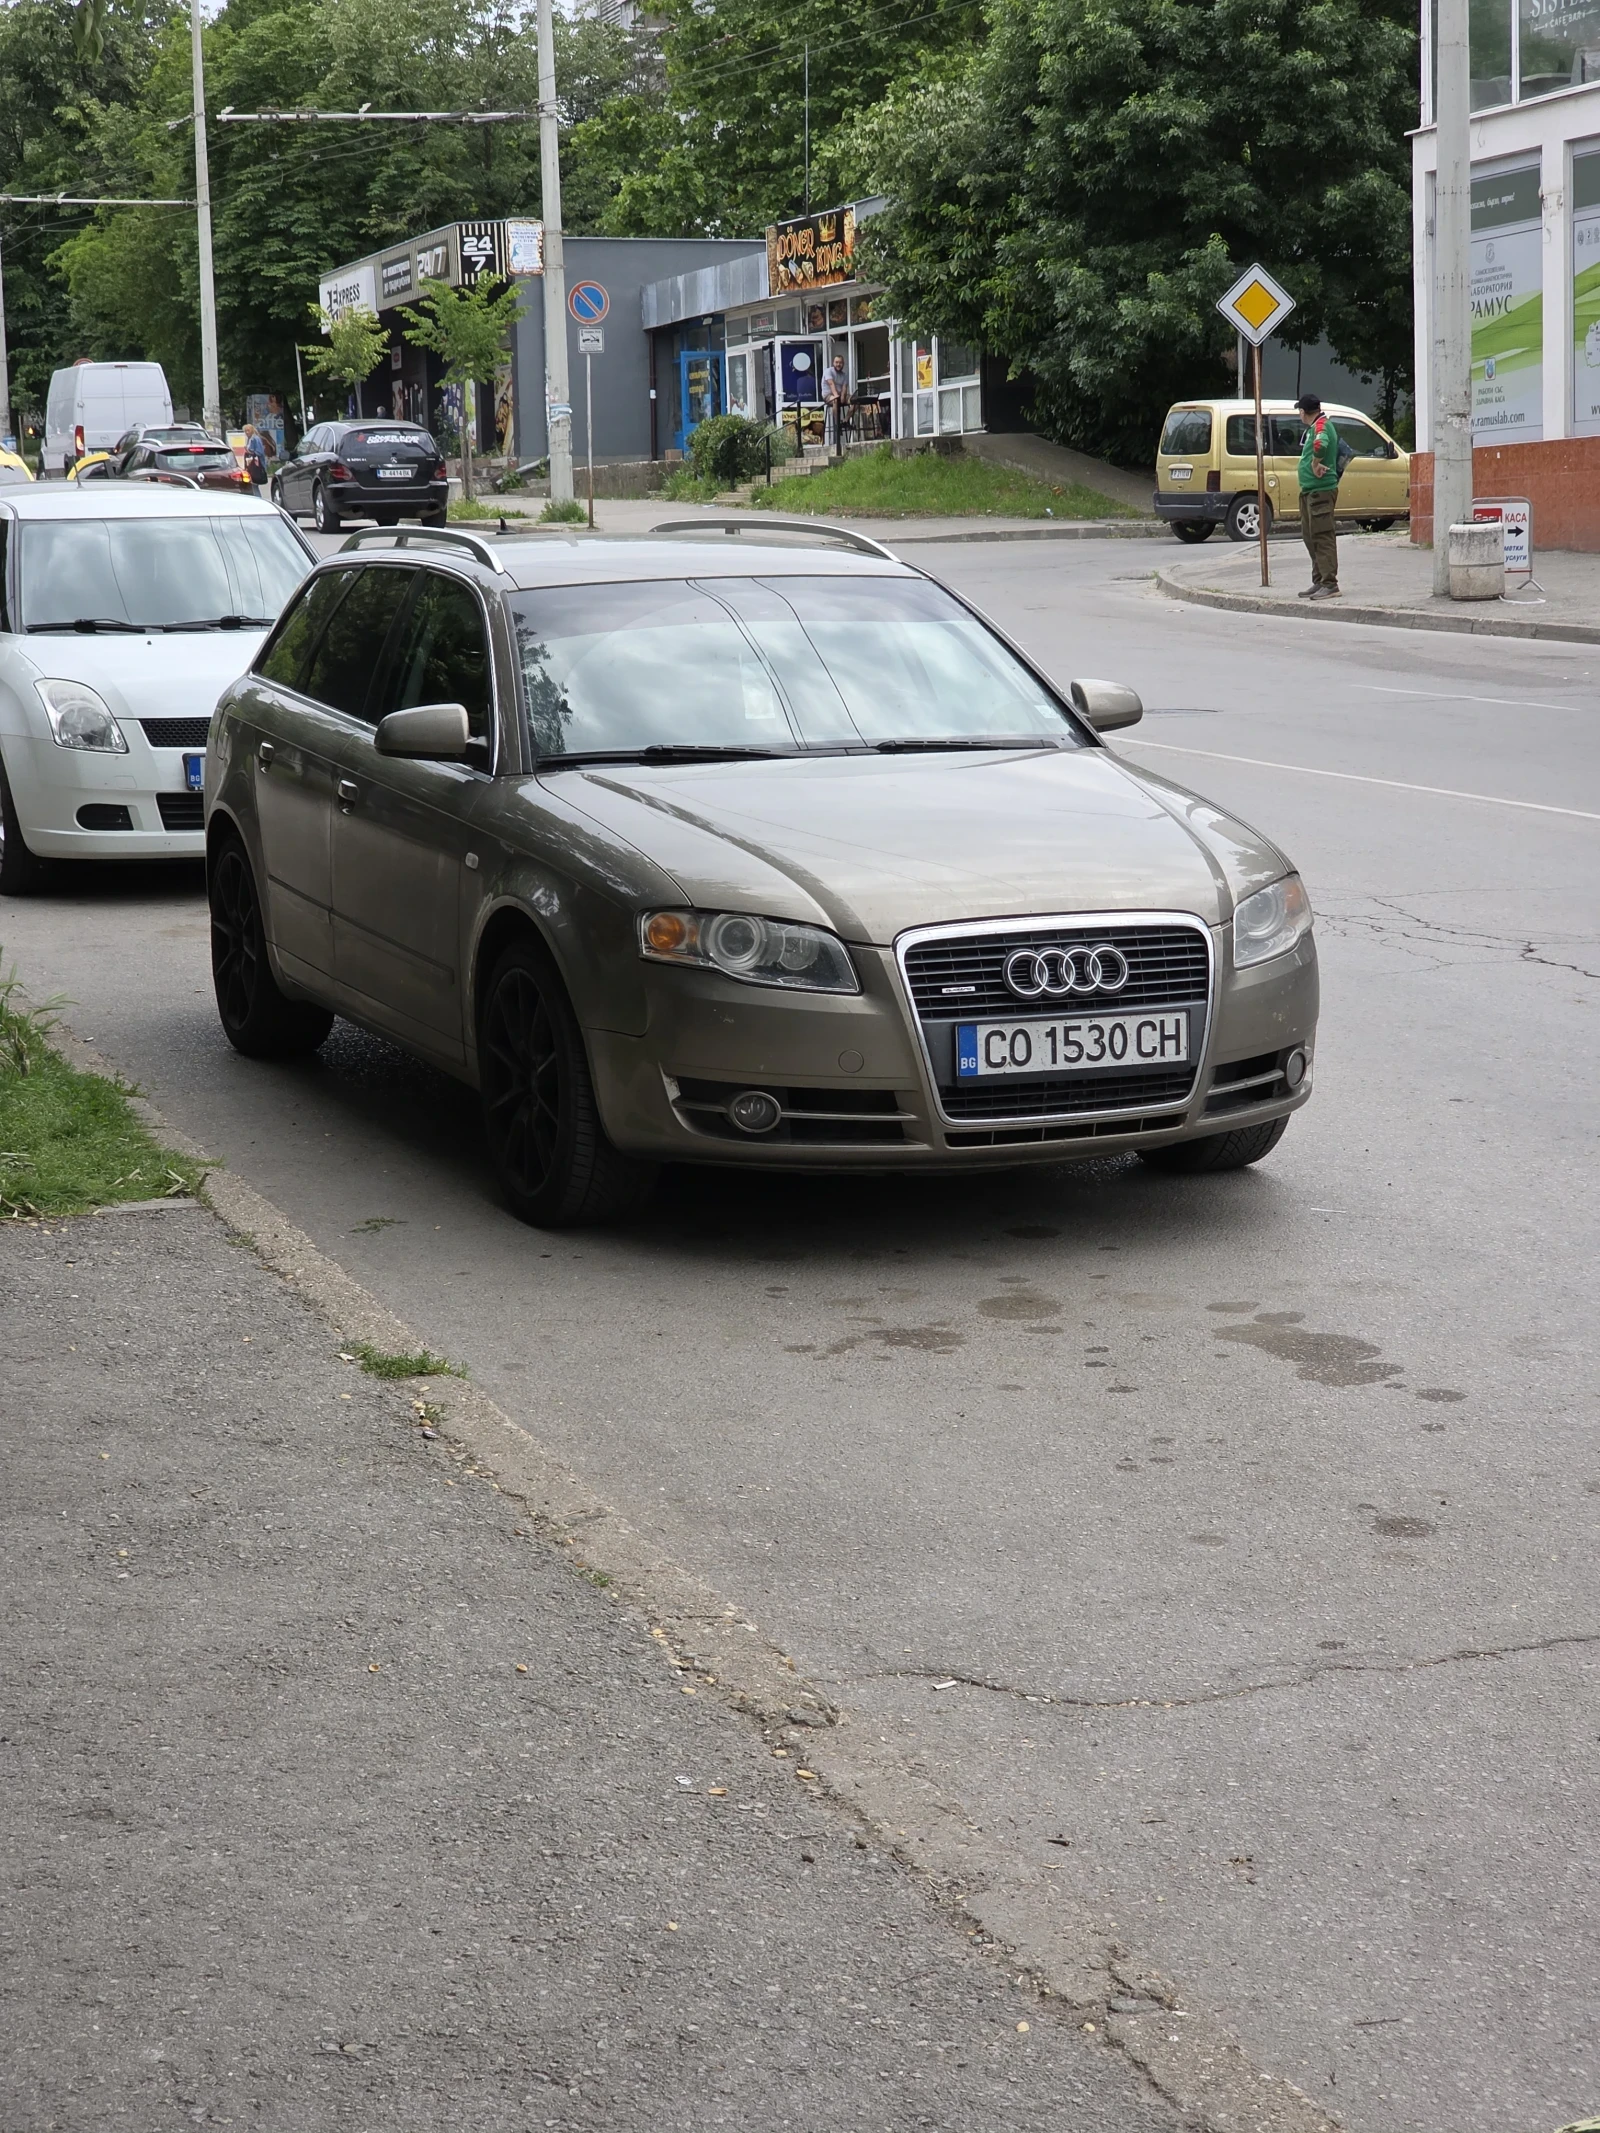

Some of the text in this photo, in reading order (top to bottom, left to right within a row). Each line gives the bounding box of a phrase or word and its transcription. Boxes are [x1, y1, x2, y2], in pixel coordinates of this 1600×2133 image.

[463, 236, 492, 251] 24
[471, 256, 486, 271] 7
[1504, 513, 1527, 523] КАСА
[1505, 554, 1527, 562] услуги
[190, 774, 200, 782] BG
[984, 1018, 1181, 1069] CO 1530 CH
[960, 1056, 976, 1070] BG
